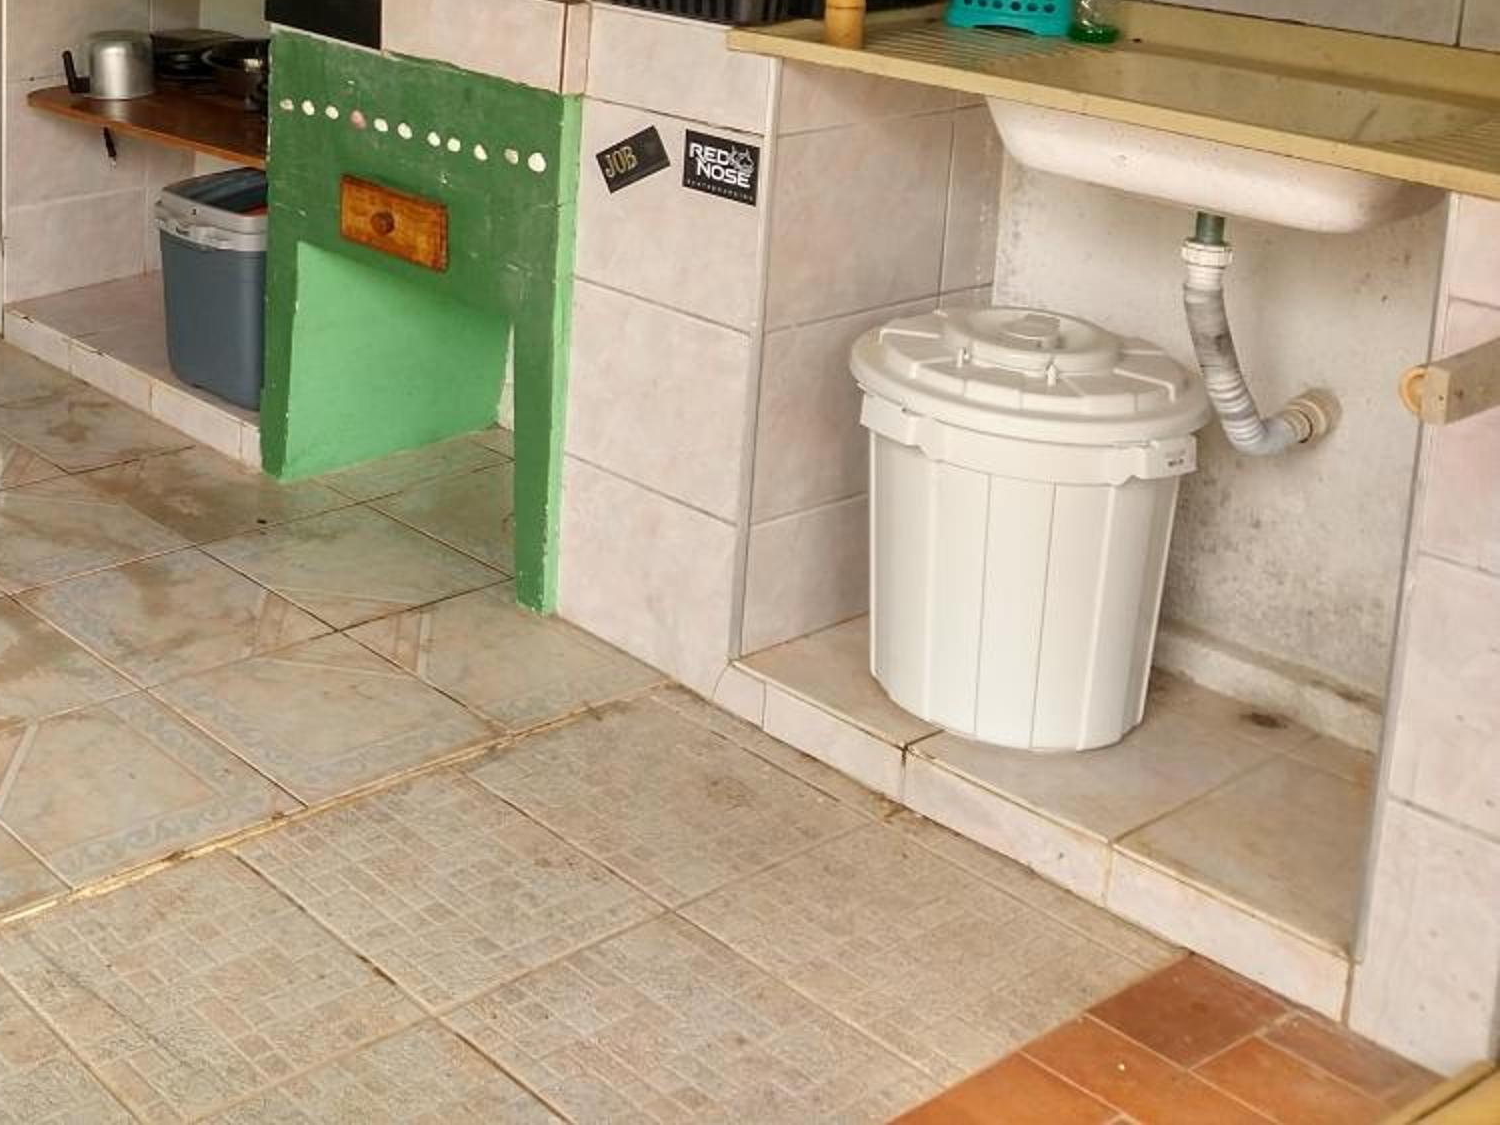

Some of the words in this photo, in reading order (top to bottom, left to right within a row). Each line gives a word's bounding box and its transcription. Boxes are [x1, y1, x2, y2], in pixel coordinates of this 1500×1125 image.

[605, 146, 637, 178] JOB
[688, 141, 730, 166] RED
[696, 160, 751, 188] NOSE
